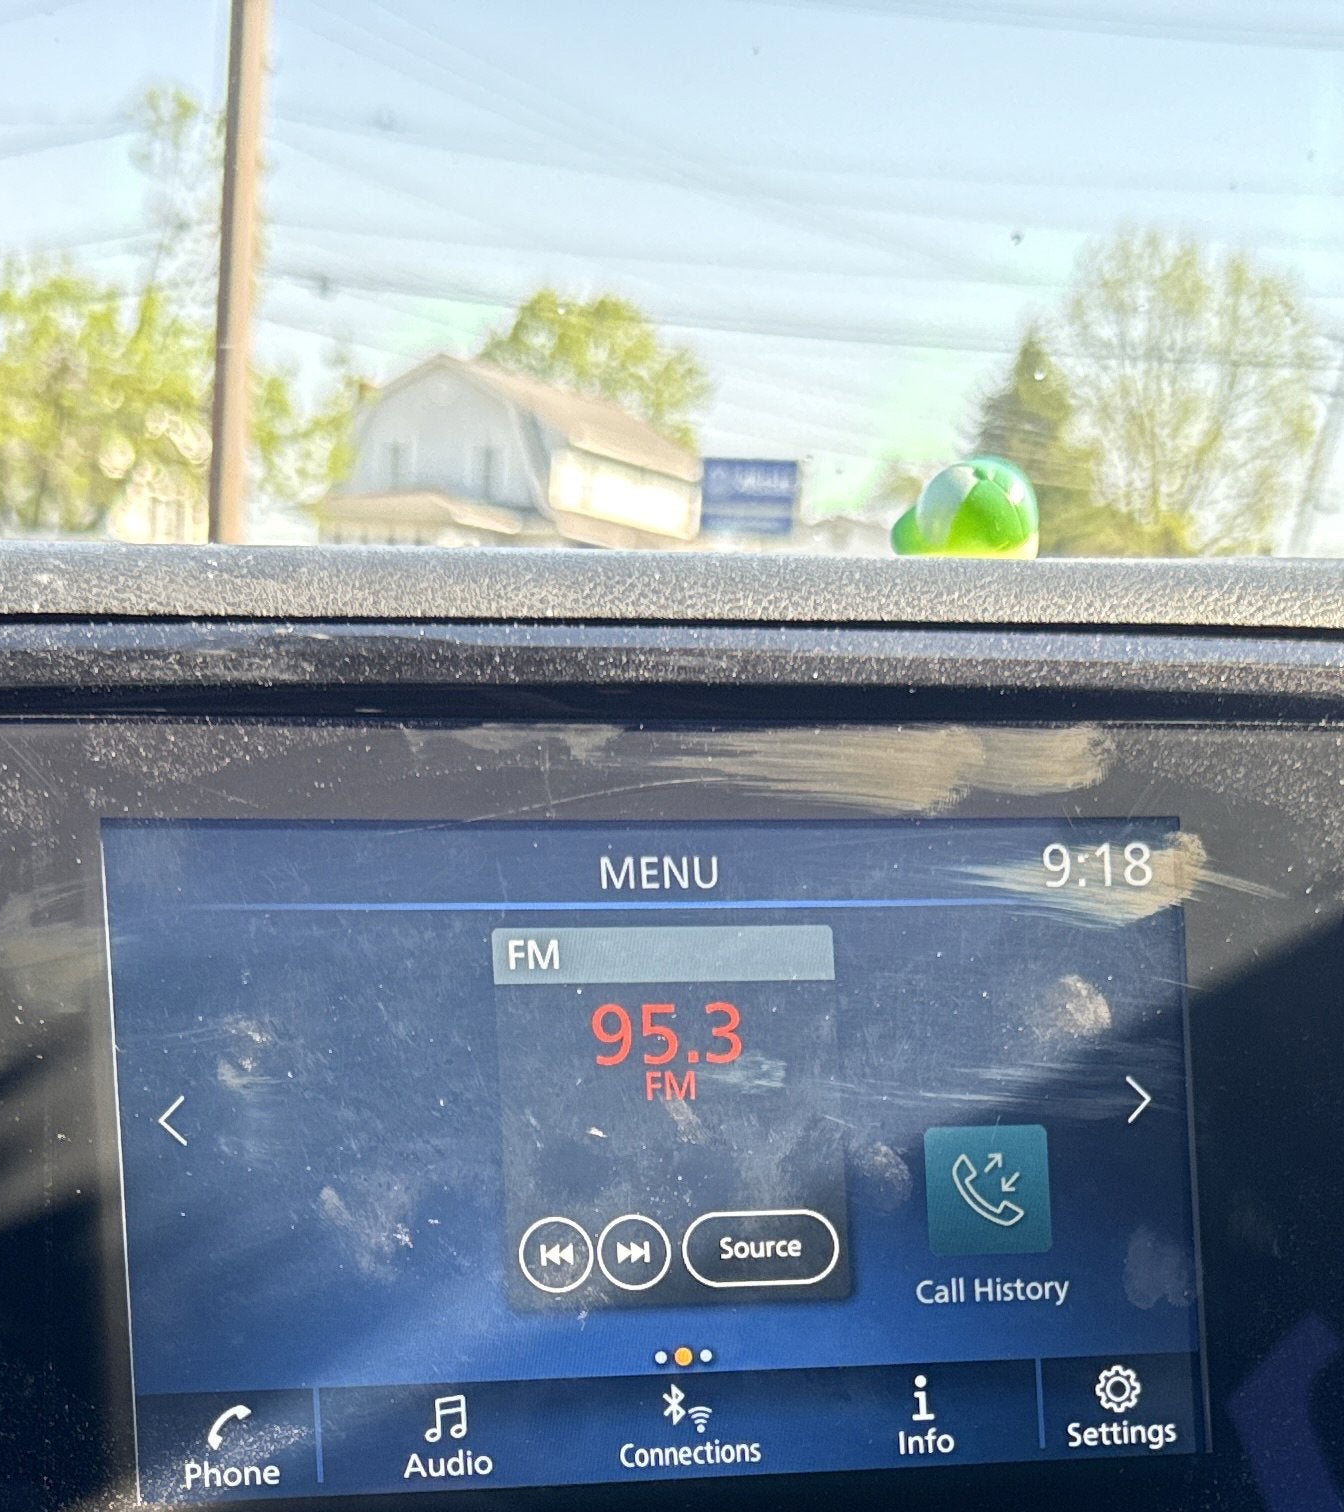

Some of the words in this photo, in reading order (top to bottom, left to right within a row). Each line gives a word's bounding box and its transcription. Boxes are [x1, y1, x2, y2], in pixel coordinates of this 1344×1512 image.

[601, 856, 718, 889] MENU
[1042, 842, 1153, 889] 9:18
[508, 939, 559, 970] FM
[592, 1002, 742, 1065] 95.3
[646, 1071, 696, 1100] FM
[720, 1237, 801, 1260] Source
[916, 1278, 965, 1304] Call
[975, 1277, 1069, 1306] History
[899, 1427, 955, 1455] Info
[1067, 1420, 1176, 1450] Settings
[404, 1449, 493, 1478] Audio
[620, 1439, 761, 1468] Connections
[183, 1462, 281, 1488] Phone
